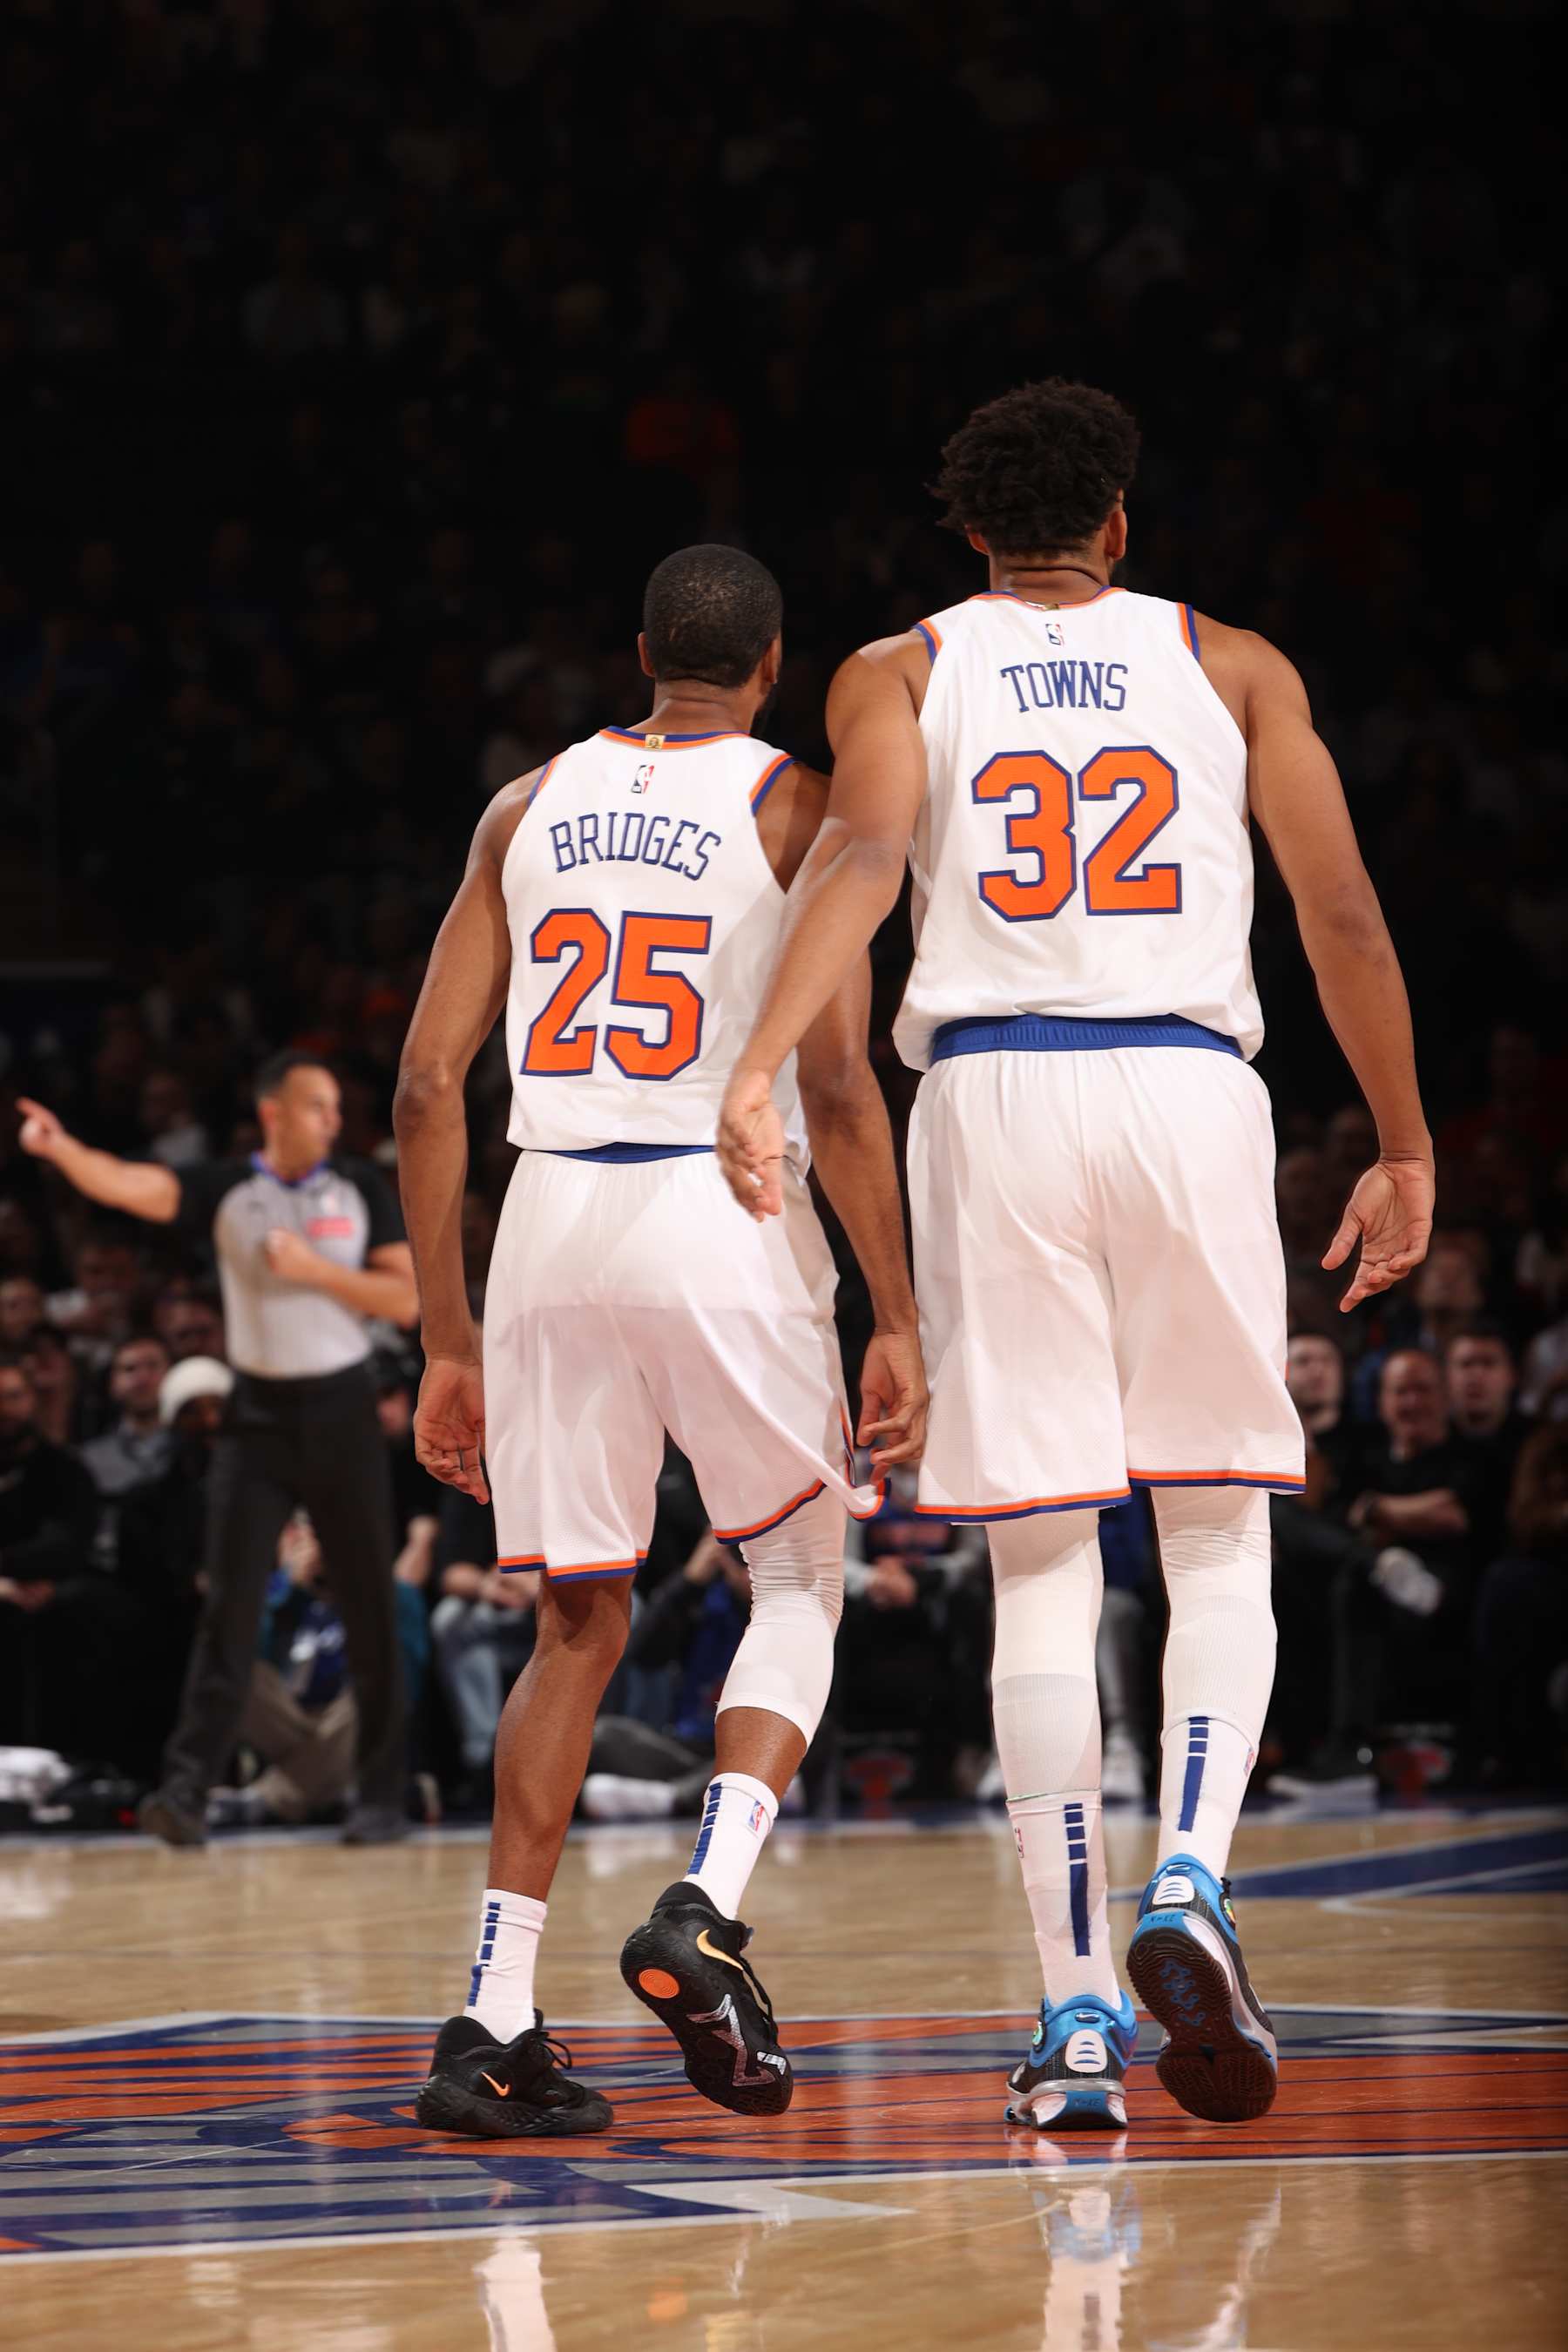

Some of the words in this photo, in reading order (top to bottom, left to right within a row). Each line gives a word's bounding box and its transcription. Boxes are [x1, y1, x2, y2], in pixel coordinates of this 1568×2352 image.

[1001, 659, 1128, 713] TOWNS
[550, 812, 721, 881] BRIDGES
[971, 745, 1181, 923] 32
[519, 908, 713, 1081] 25
